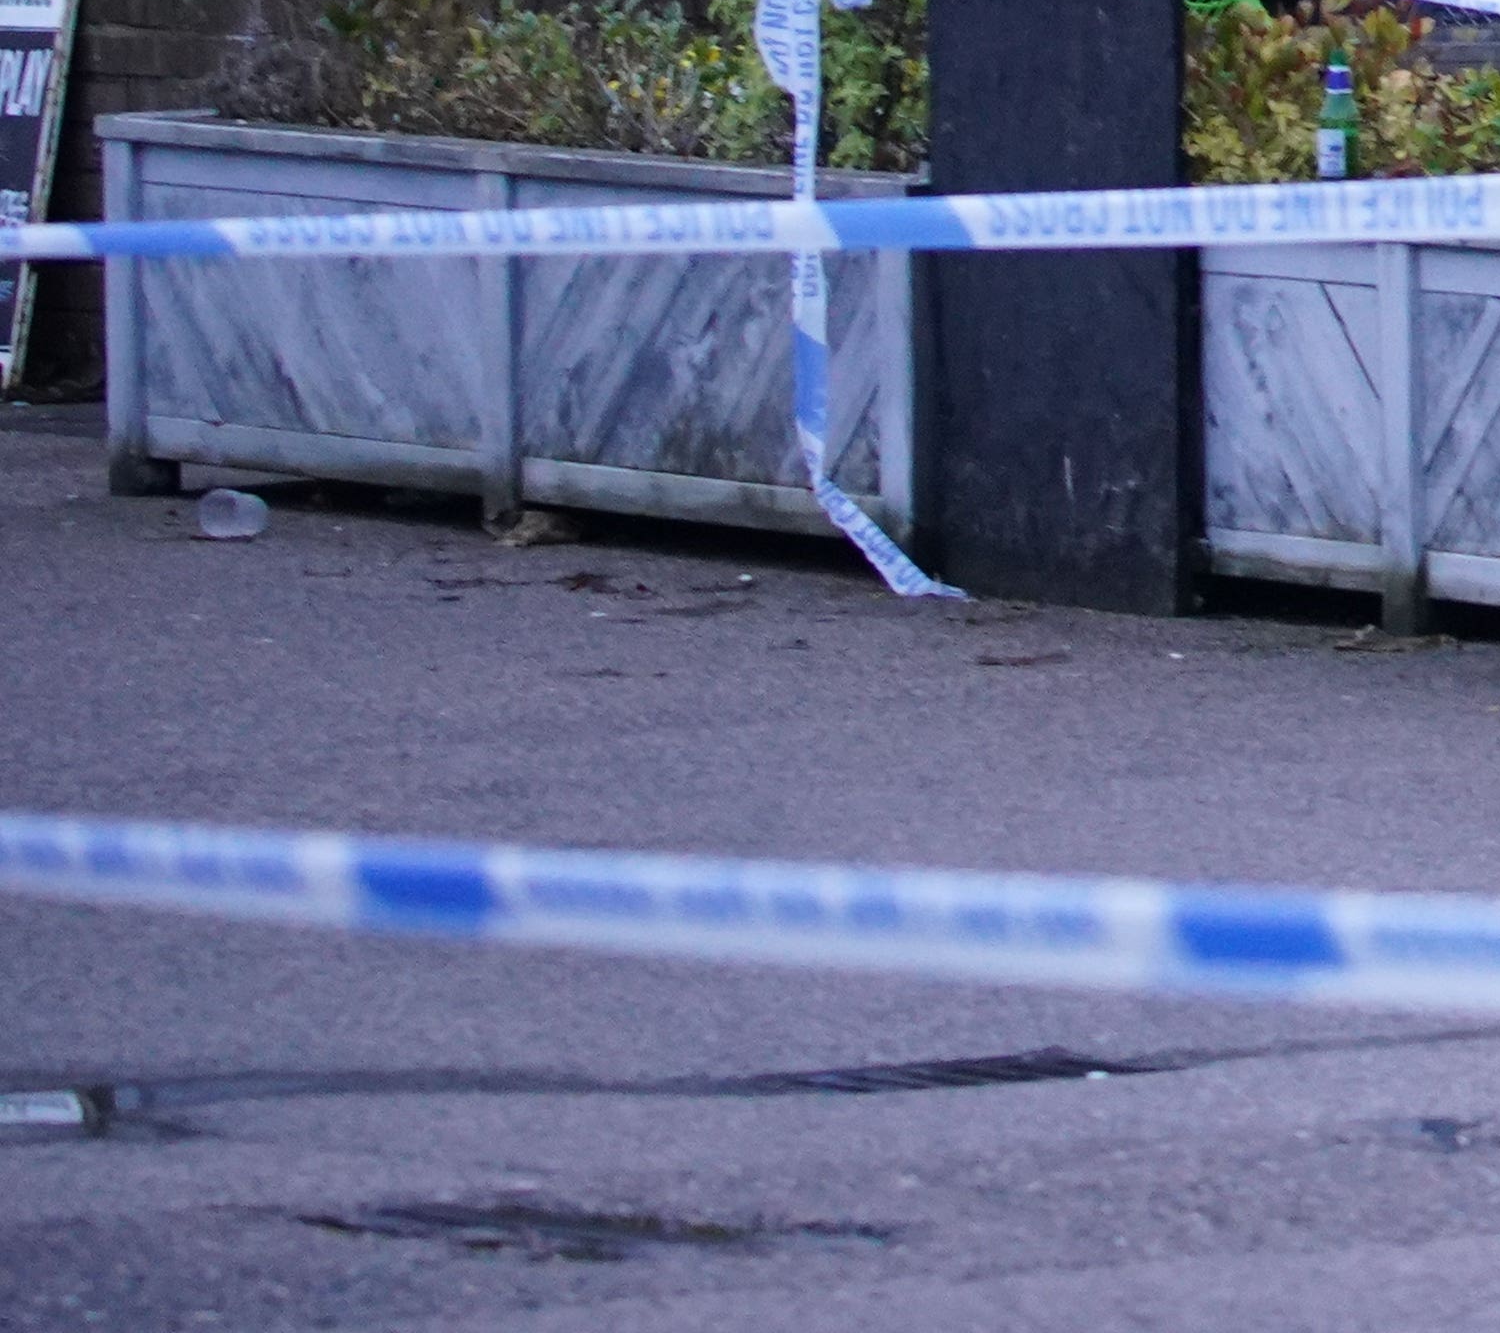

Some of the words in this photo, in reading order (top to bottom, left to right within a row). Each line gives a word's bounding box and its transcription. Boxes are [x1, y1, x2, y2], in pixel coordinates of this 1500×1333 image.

[643, 201, 776, 243] POLICE
[988, 194, 1111, 239] CROSS
[1123, 191, 1196, 236] NOT
[1206, 189, 1258, 234] DO
[1271, 186, 1348, 233] LINE
[1361, 183, 1484, 231] POLICE
